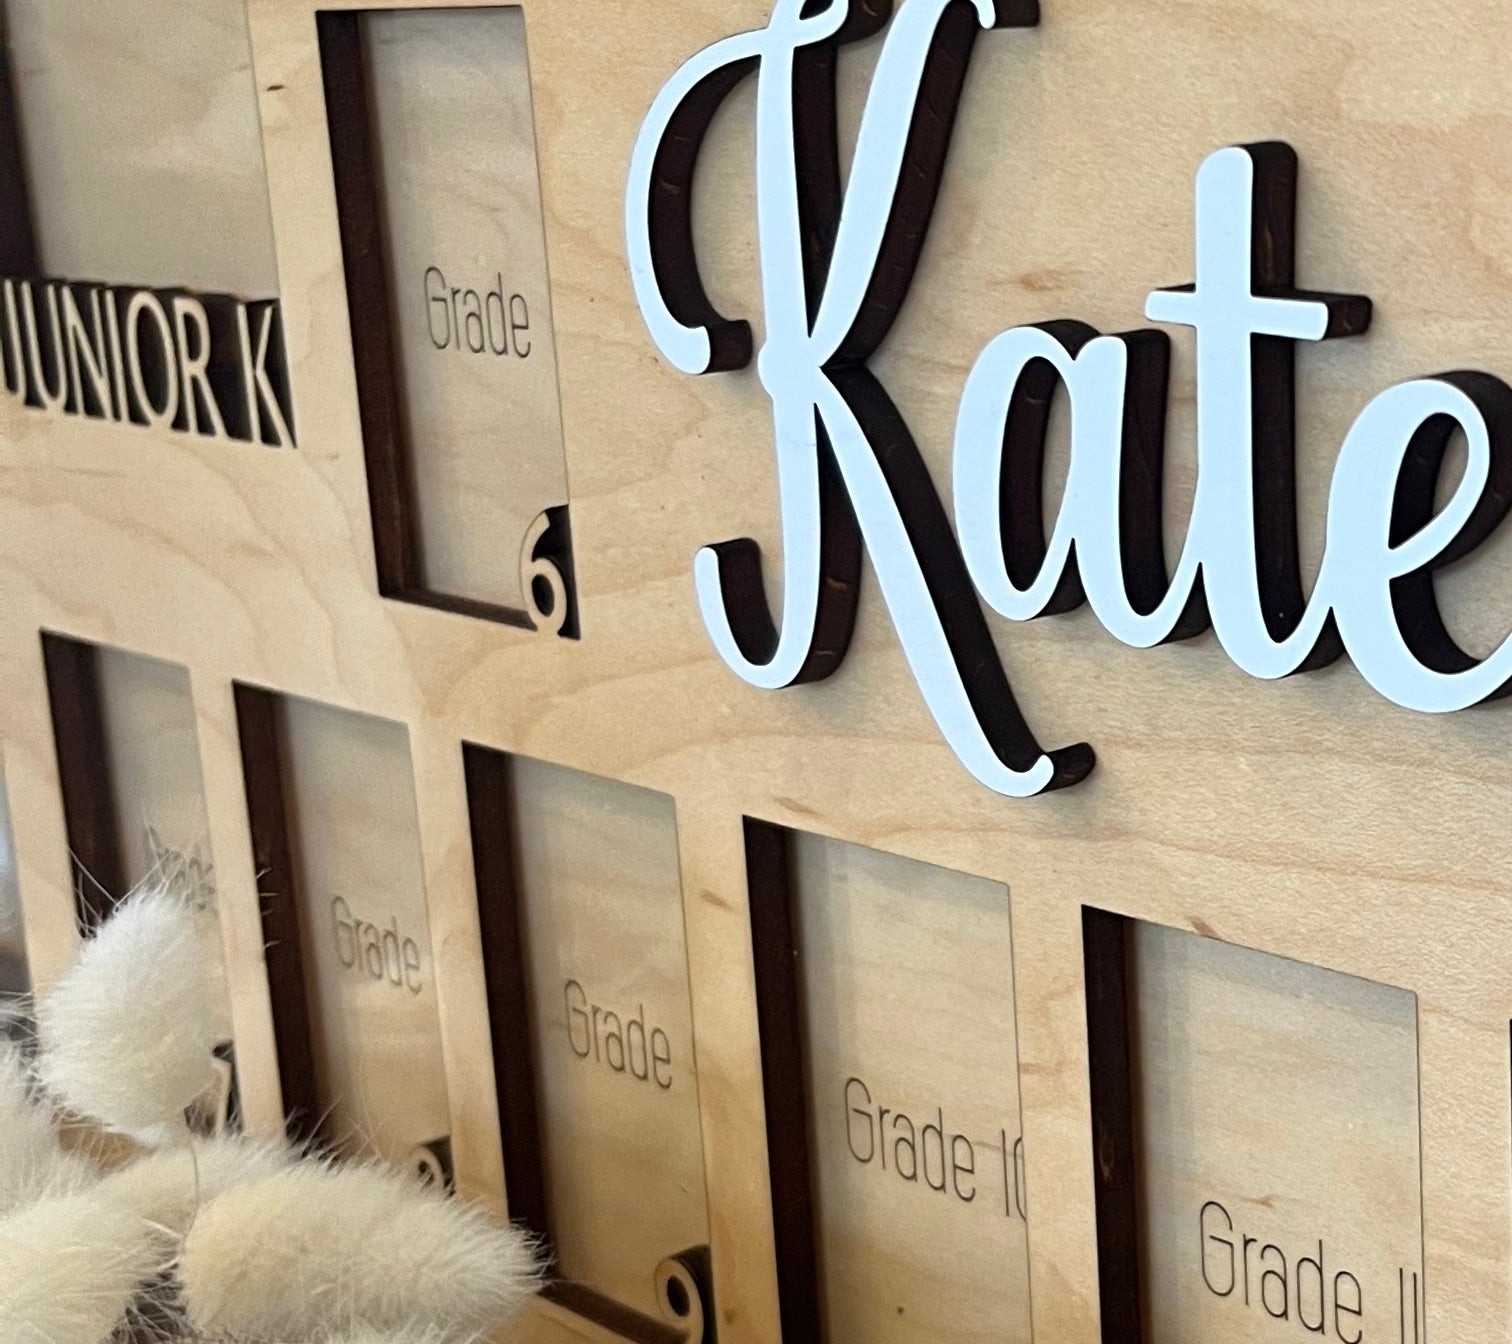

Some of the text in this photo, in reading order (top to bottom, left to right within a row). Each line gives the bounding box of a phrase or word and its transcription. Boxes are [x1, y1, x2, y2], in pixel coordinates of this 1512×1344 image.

[0, 278, 297, 448] JUNIOR K
[424, 265, 531, 358] Grade
[518, 508, 571, 636] 6
[332, 895, 422, 996] Grade
[563, 978, 673, 1089] Grade
[844, 1077, 977, 1202] Grade
